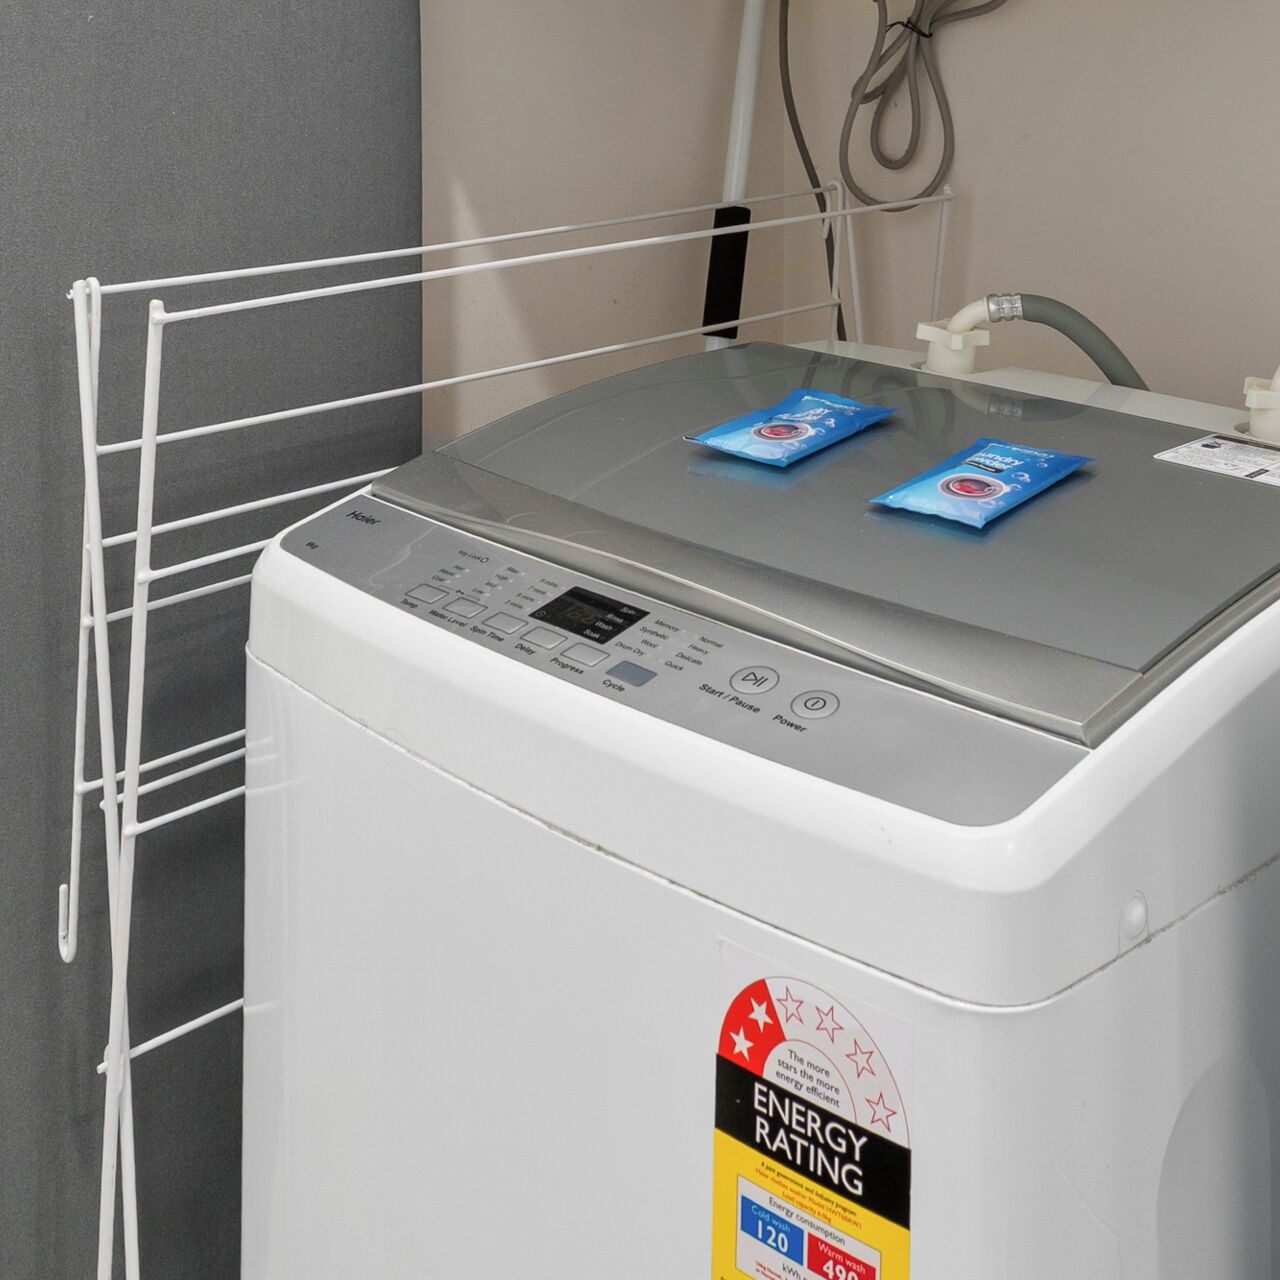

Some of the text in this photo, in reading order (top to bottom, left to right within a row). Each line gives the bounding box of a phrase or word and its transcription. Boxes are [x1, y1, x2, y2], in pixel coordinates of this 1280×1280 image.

[346, 510, 381, 525] Haier
[429, 608, 469, 629] Water Level
[655, 619, 680, 632] Memory
[470, 624, 505, 643] Spin Time
[515, 642, 537, 656] Delay
[632, 647, 646, 657] Dry
[549, 656, 586, 676] Progress
[602, 679, 626, 693] Cycle
[699, 682, 724, 700] Start
[729, 695, 762, 714] Pause
[772, 713, 807, 734] Power
[788, 1048, 831, 1078] The more
[775, 1070, 840, 1108] energy efficient
[777, 1058, 840, 1095] stars the more
[754, 1081, 869, 1162] ENERGY
[755, 1115, 863, 1196] RATING
[751, 1204, 791, 1233] Cold wash
[769, 1196, 846, 1246] Energy consumption
[757, 1220, 789, 1254] 120
[818, 1241, 867, 1275] Warm wash
[782, 1263, 801, 1280] kWh
